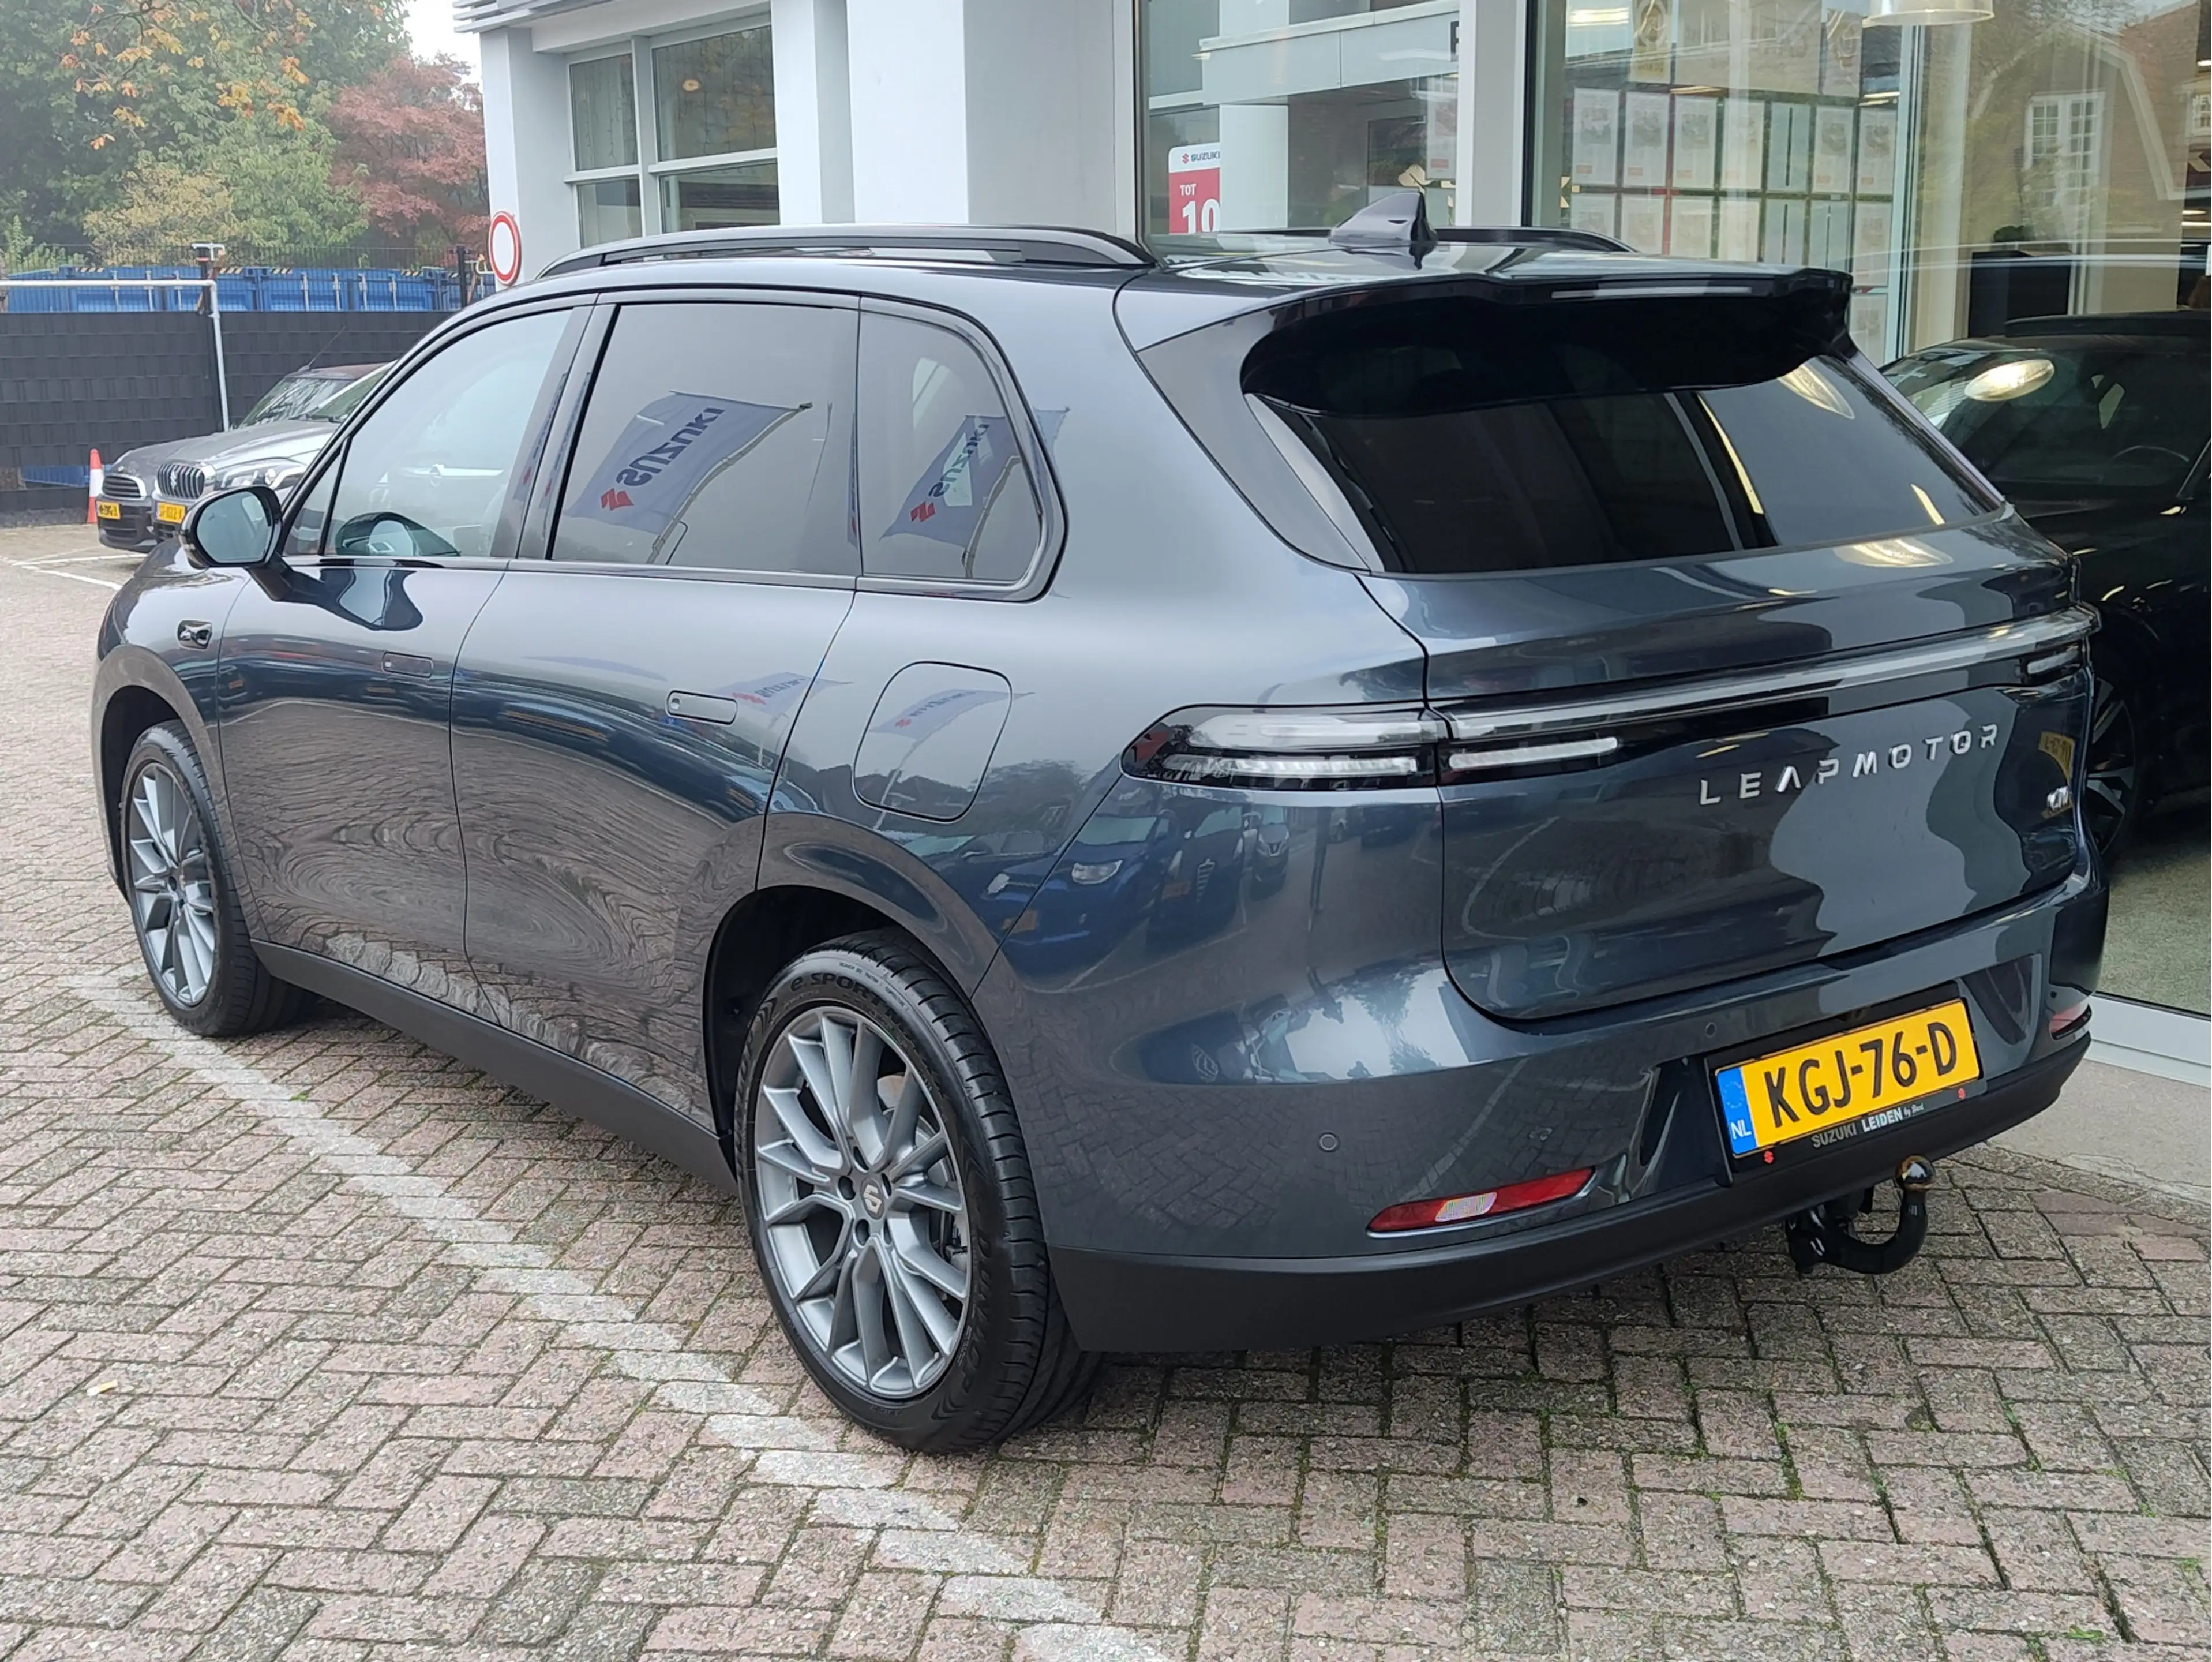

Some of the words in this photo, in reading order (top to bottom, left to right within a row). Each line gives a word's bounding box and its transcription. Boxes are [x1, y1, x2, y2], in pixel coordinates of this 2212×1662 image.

[1191, 151, 1220, 162] SUZUKI
[1179, 183, 1197, 196] TOT
[1182, 198, 1221, 234] 10
[1699, 723, 1998, 806] LEAPMOTOR
[1764, 1021, 1957, 1128] KGJ-76-D
[1730, 1120, 1752, 1140] NL
[1811, 1122, 1857, 1148] SUZUKI
[1861, 1107, 1903, 1133] LEIDEN
